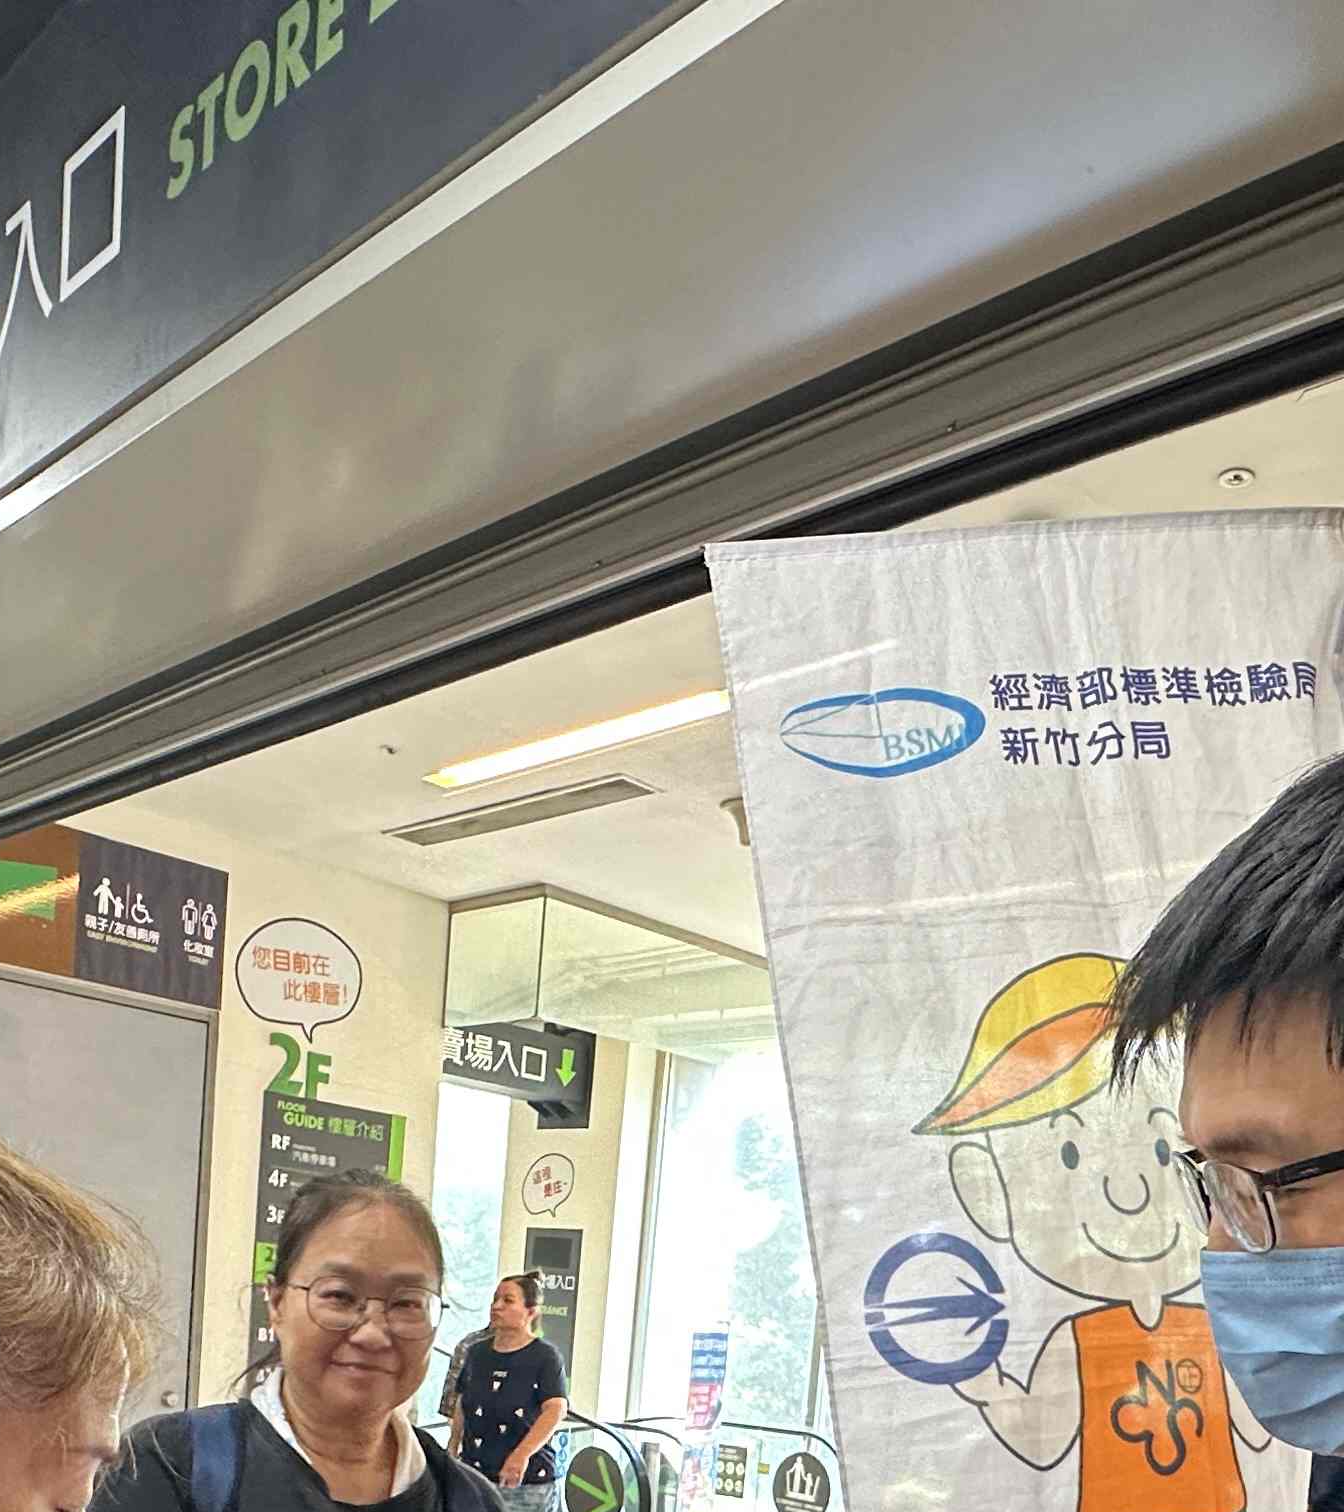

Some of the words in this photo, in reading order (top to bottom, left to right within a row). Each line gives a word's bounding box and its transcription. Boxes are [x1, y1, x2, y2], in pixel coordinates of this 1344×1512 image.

[166, 0, 345, 199] STORE
[989, 660, 1318, 713] 經濟部標準檢驗局
[1001, 720, 1172, 767] 新竹分局
[252, 944, 331, 977] 您目前在
[265, 1032, 332, 1100] 2F
[441, 1026, 548, 1083] 賣場入口
[277, 1100, 306, 1113] FLOOR
[283, 1111, 326, 1130] GUIDE
[271, 1133, 292, 1151] RF
[268, 1168, 289, 1188] 4F
[266, 1205, 286, 1225] 3F
